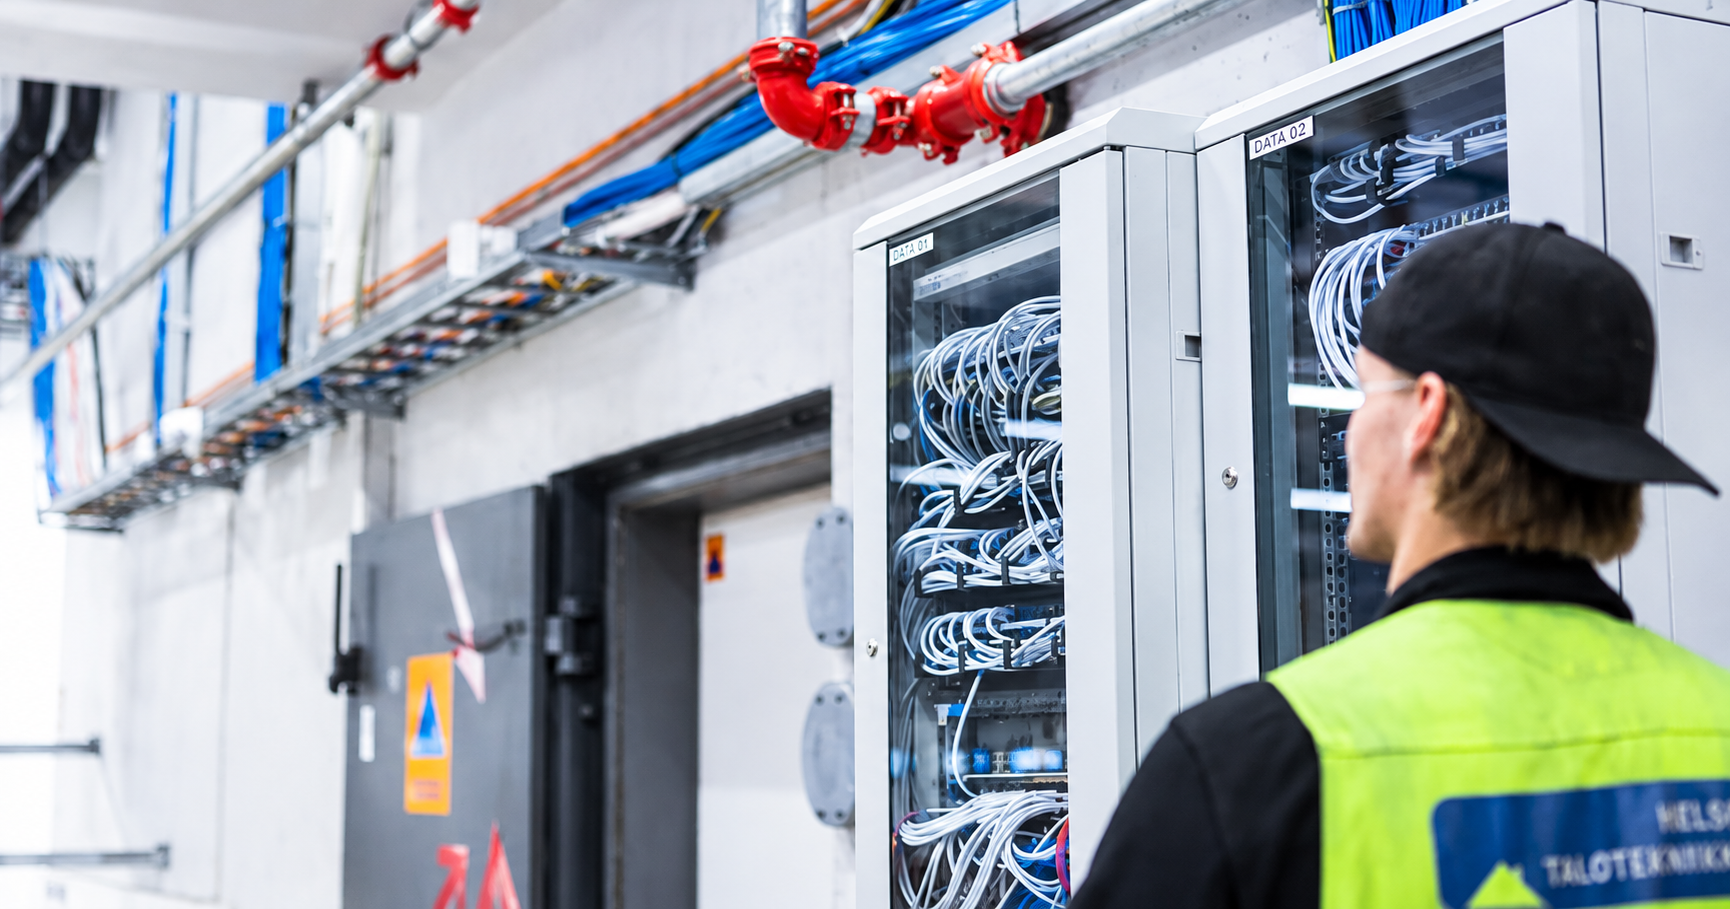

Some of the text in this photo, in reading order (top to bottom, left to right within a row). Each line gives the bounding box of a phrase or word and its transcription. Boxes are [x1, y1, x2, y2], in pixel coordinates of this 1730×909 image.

[1254, 122, 1306, 153] DATA 02
[893, 238, 928, 261] DATA 01
